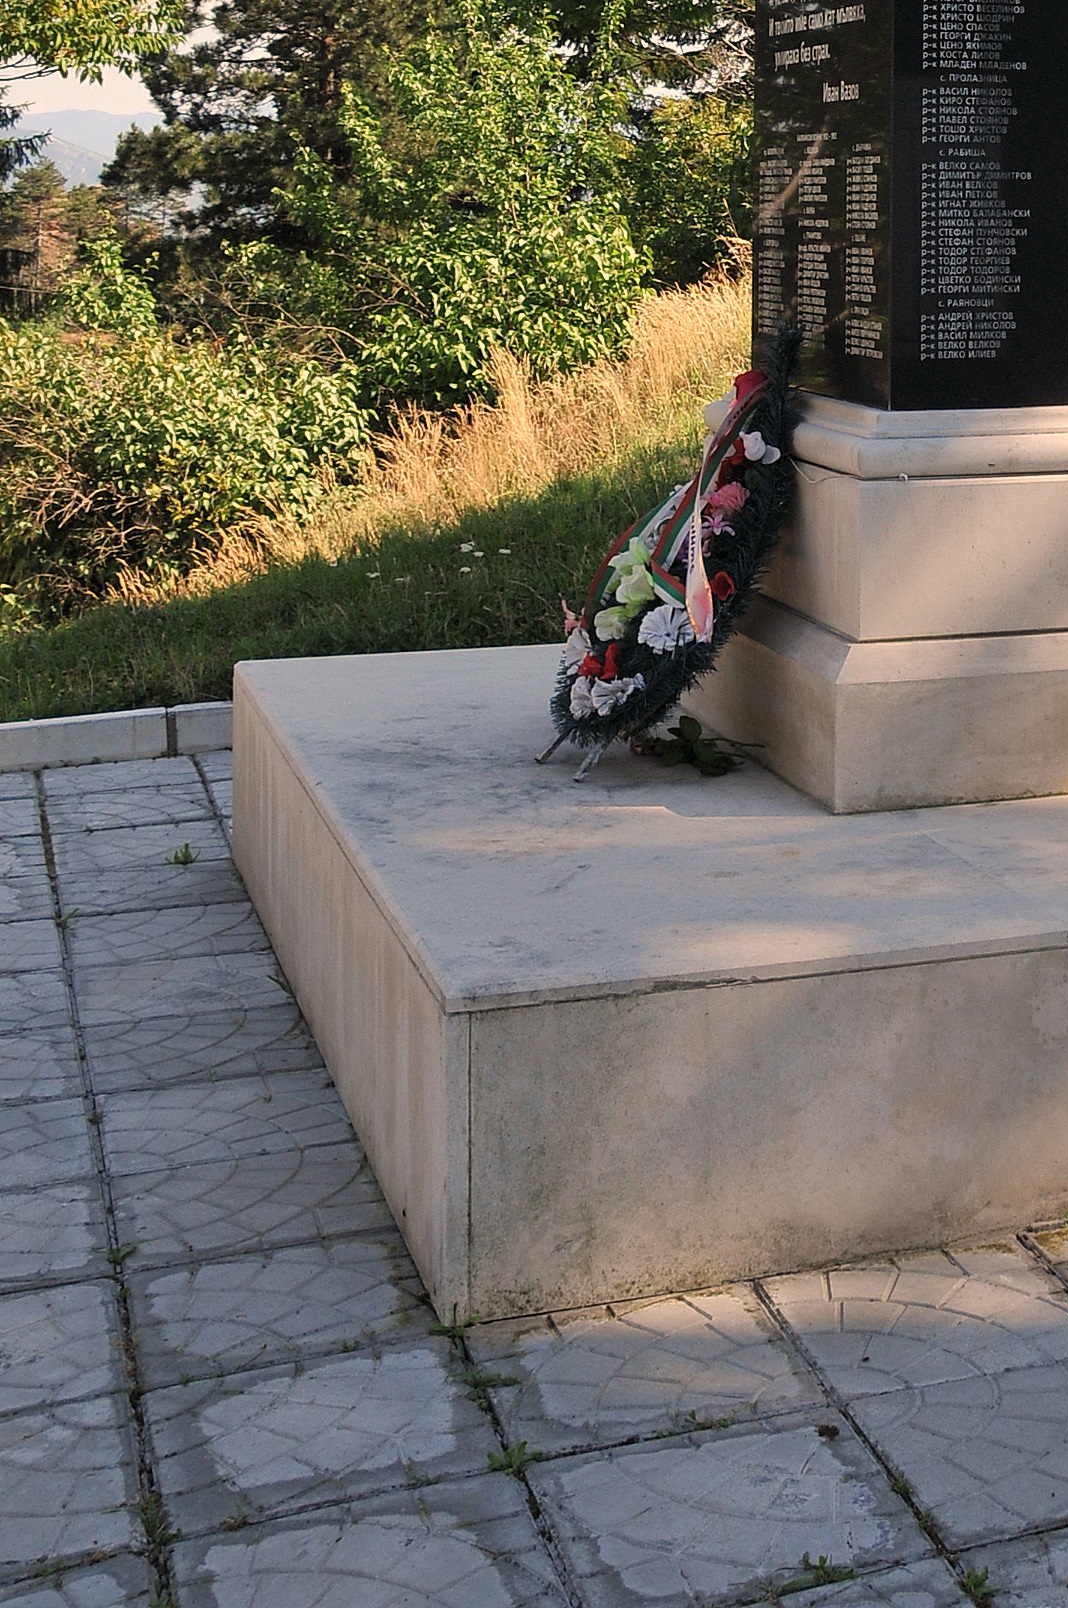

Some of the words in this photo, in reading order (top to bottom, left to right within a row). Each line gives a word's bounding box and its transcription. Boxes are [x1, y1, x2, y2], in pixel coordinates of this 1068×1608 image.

[800, 41, 810, 62] без
[812, 44, 831, 65] страх.
[823, 82, 839, 102] Иван
[840, 80, 859, 100] Вазов
[922, 116, 936, 125] р-к
[921, 210, 936, 219] р-к
[921, 238, 936, 247] р-к
[921, 268, 935, 276] р-к
[920, 333, 935, 341] р-к
[920, 352, 934, 360] р-к
